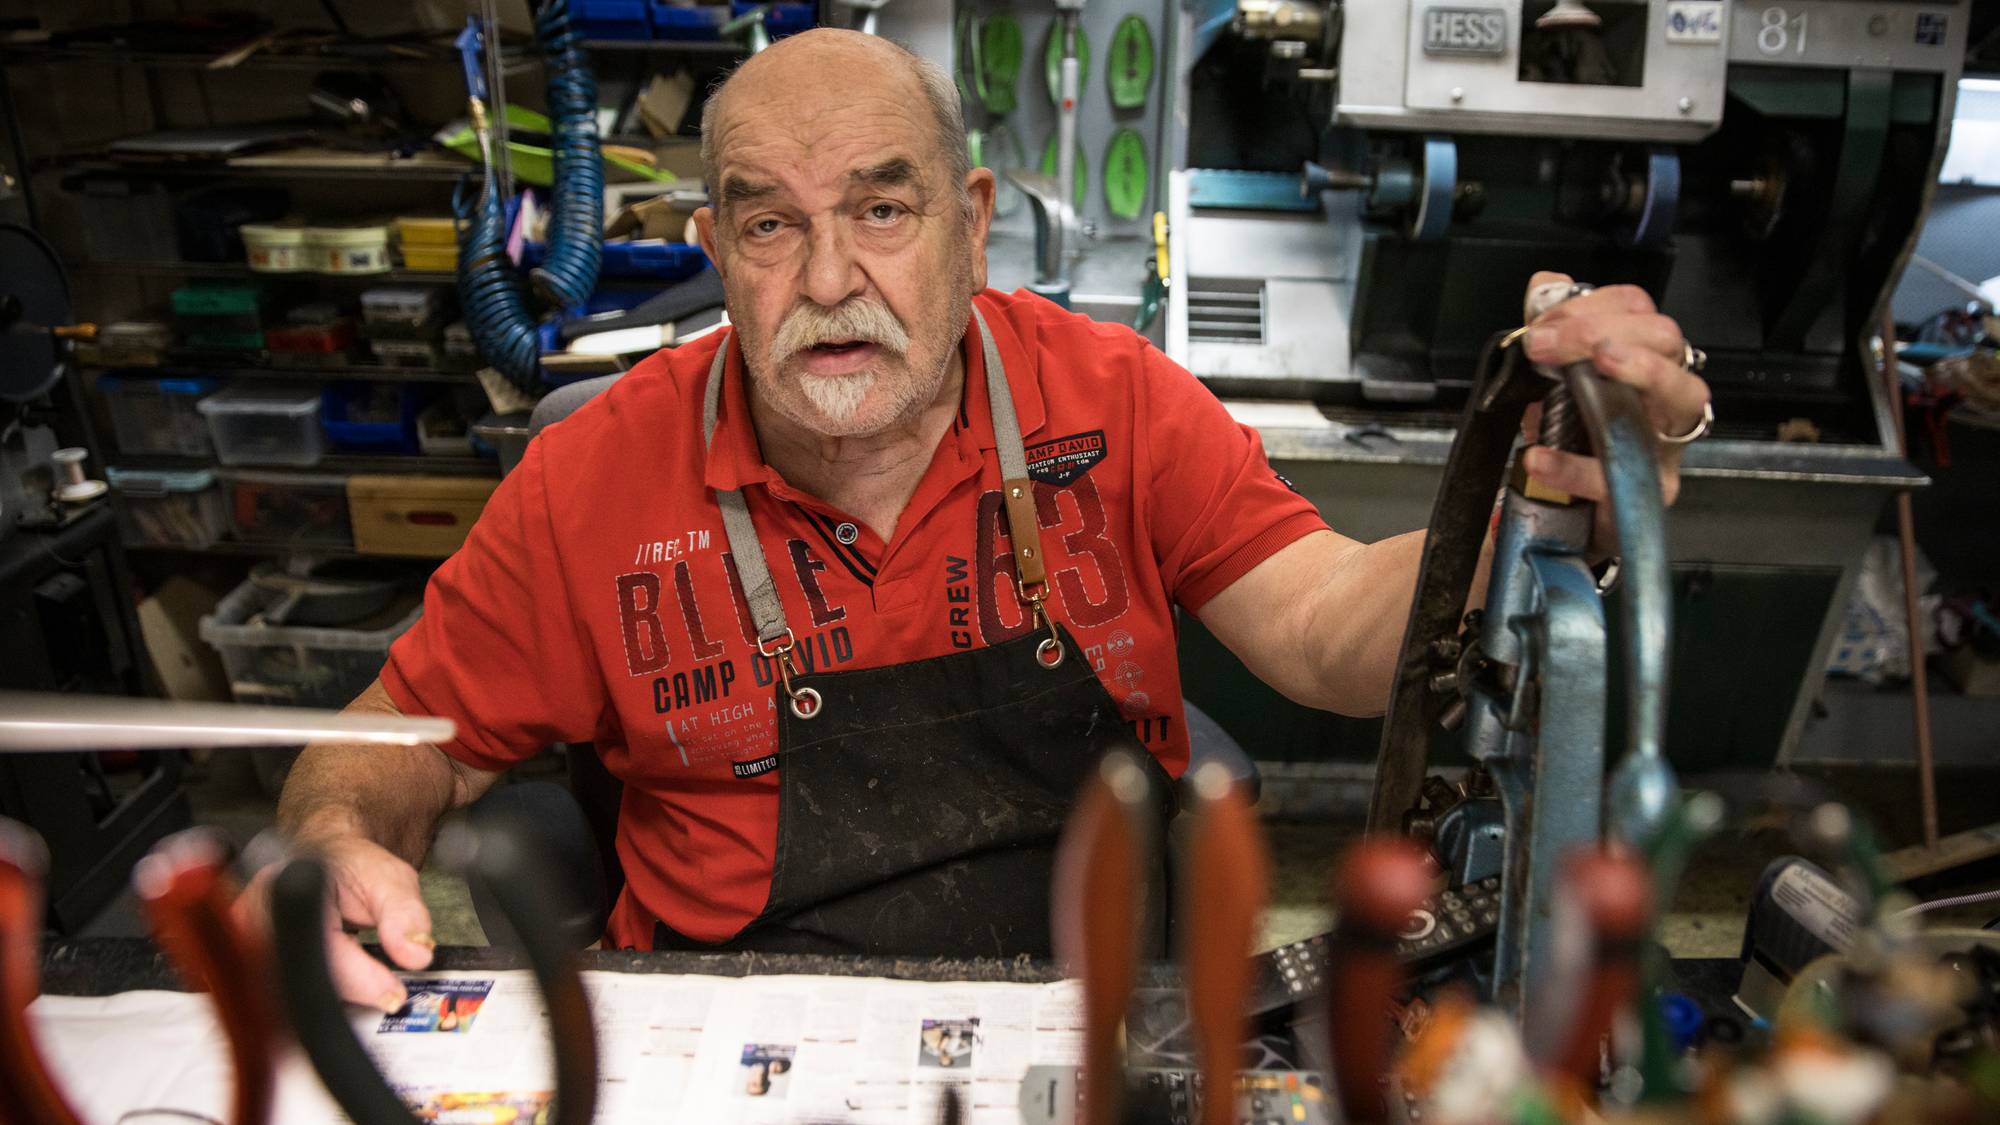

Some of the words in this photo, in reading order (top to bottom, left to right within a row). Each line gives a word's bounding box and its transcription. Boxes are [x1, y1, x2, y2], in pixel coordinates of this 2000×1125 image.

[1428, 12, 1503, 45] HESS
[1758, 6, 1809, 56] 81
[1027, 447, 1055, 462] AMP
[1059, 438, 1098, 452] DAVID
[1027, 459, 1055, 470] VIATION
[1058, 450, 1100, 463] ENTHUSIAST
[976, 472, 1131, 648] 63
[946, 556, 972, 649] CREW
[652, 660, 736, 715] CAMP
[752, 626, 853, 688] DVID
[681, 715, 699, 733] AT
[711, 702, 754, 727] HIGH
[743, 757, 777, 775] LIMITED
